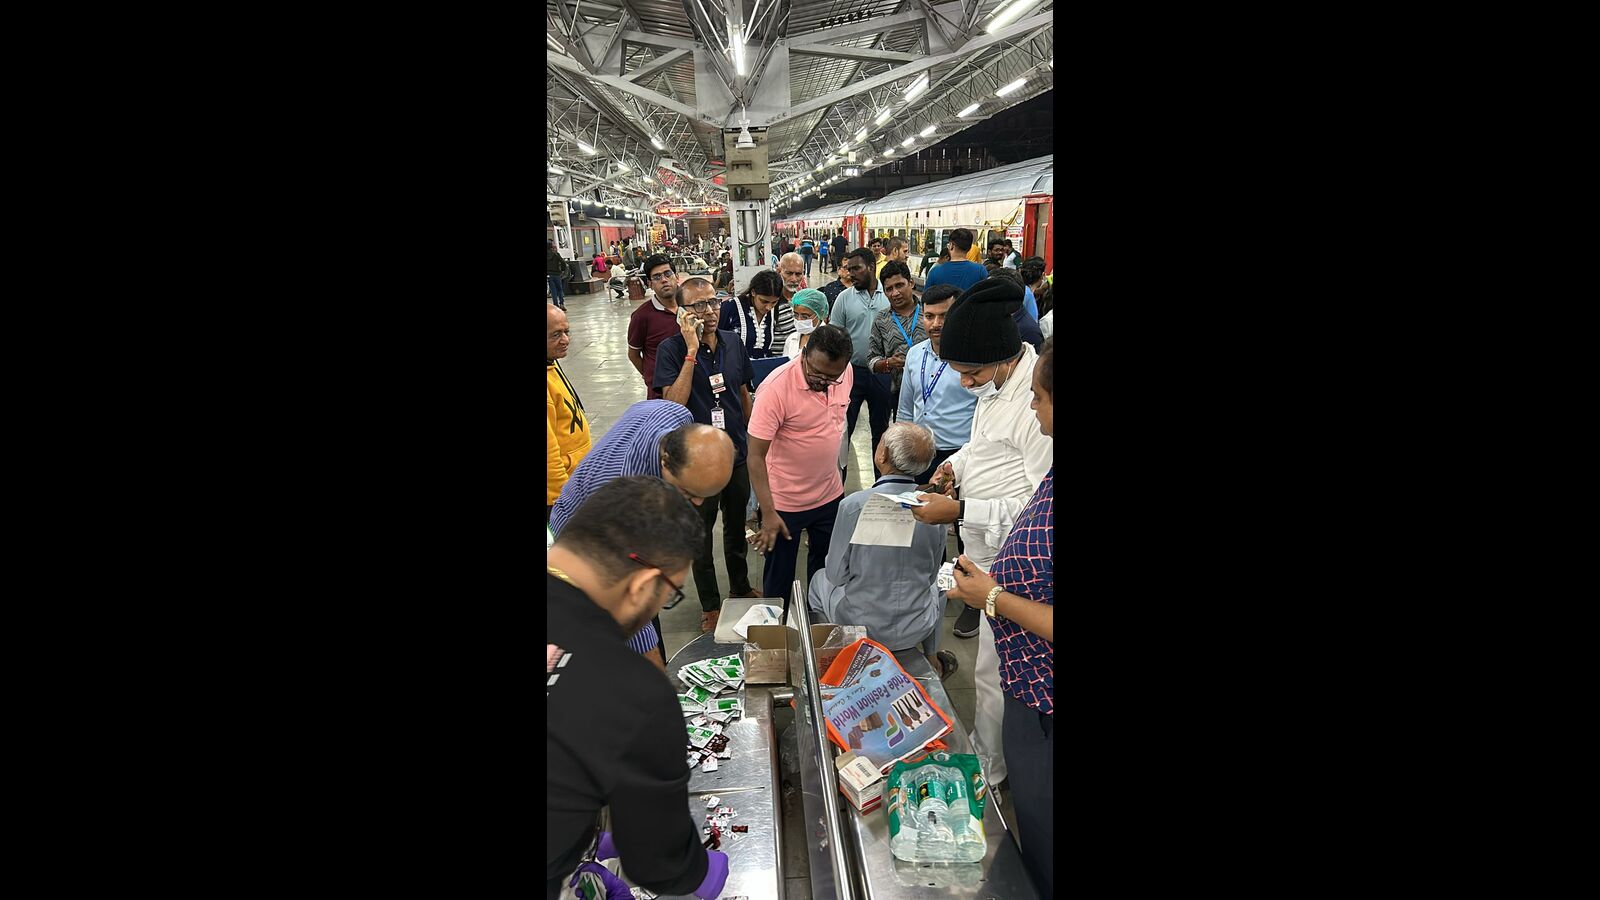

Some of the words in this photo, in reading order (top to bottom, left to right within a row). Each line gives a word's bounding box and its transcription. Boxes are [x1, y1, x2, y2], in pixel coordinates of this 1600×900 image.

[887, 674, 911, 690] Pride
[856, 684, 890, 711] Fashion
[832, 705, 860, 731] World
